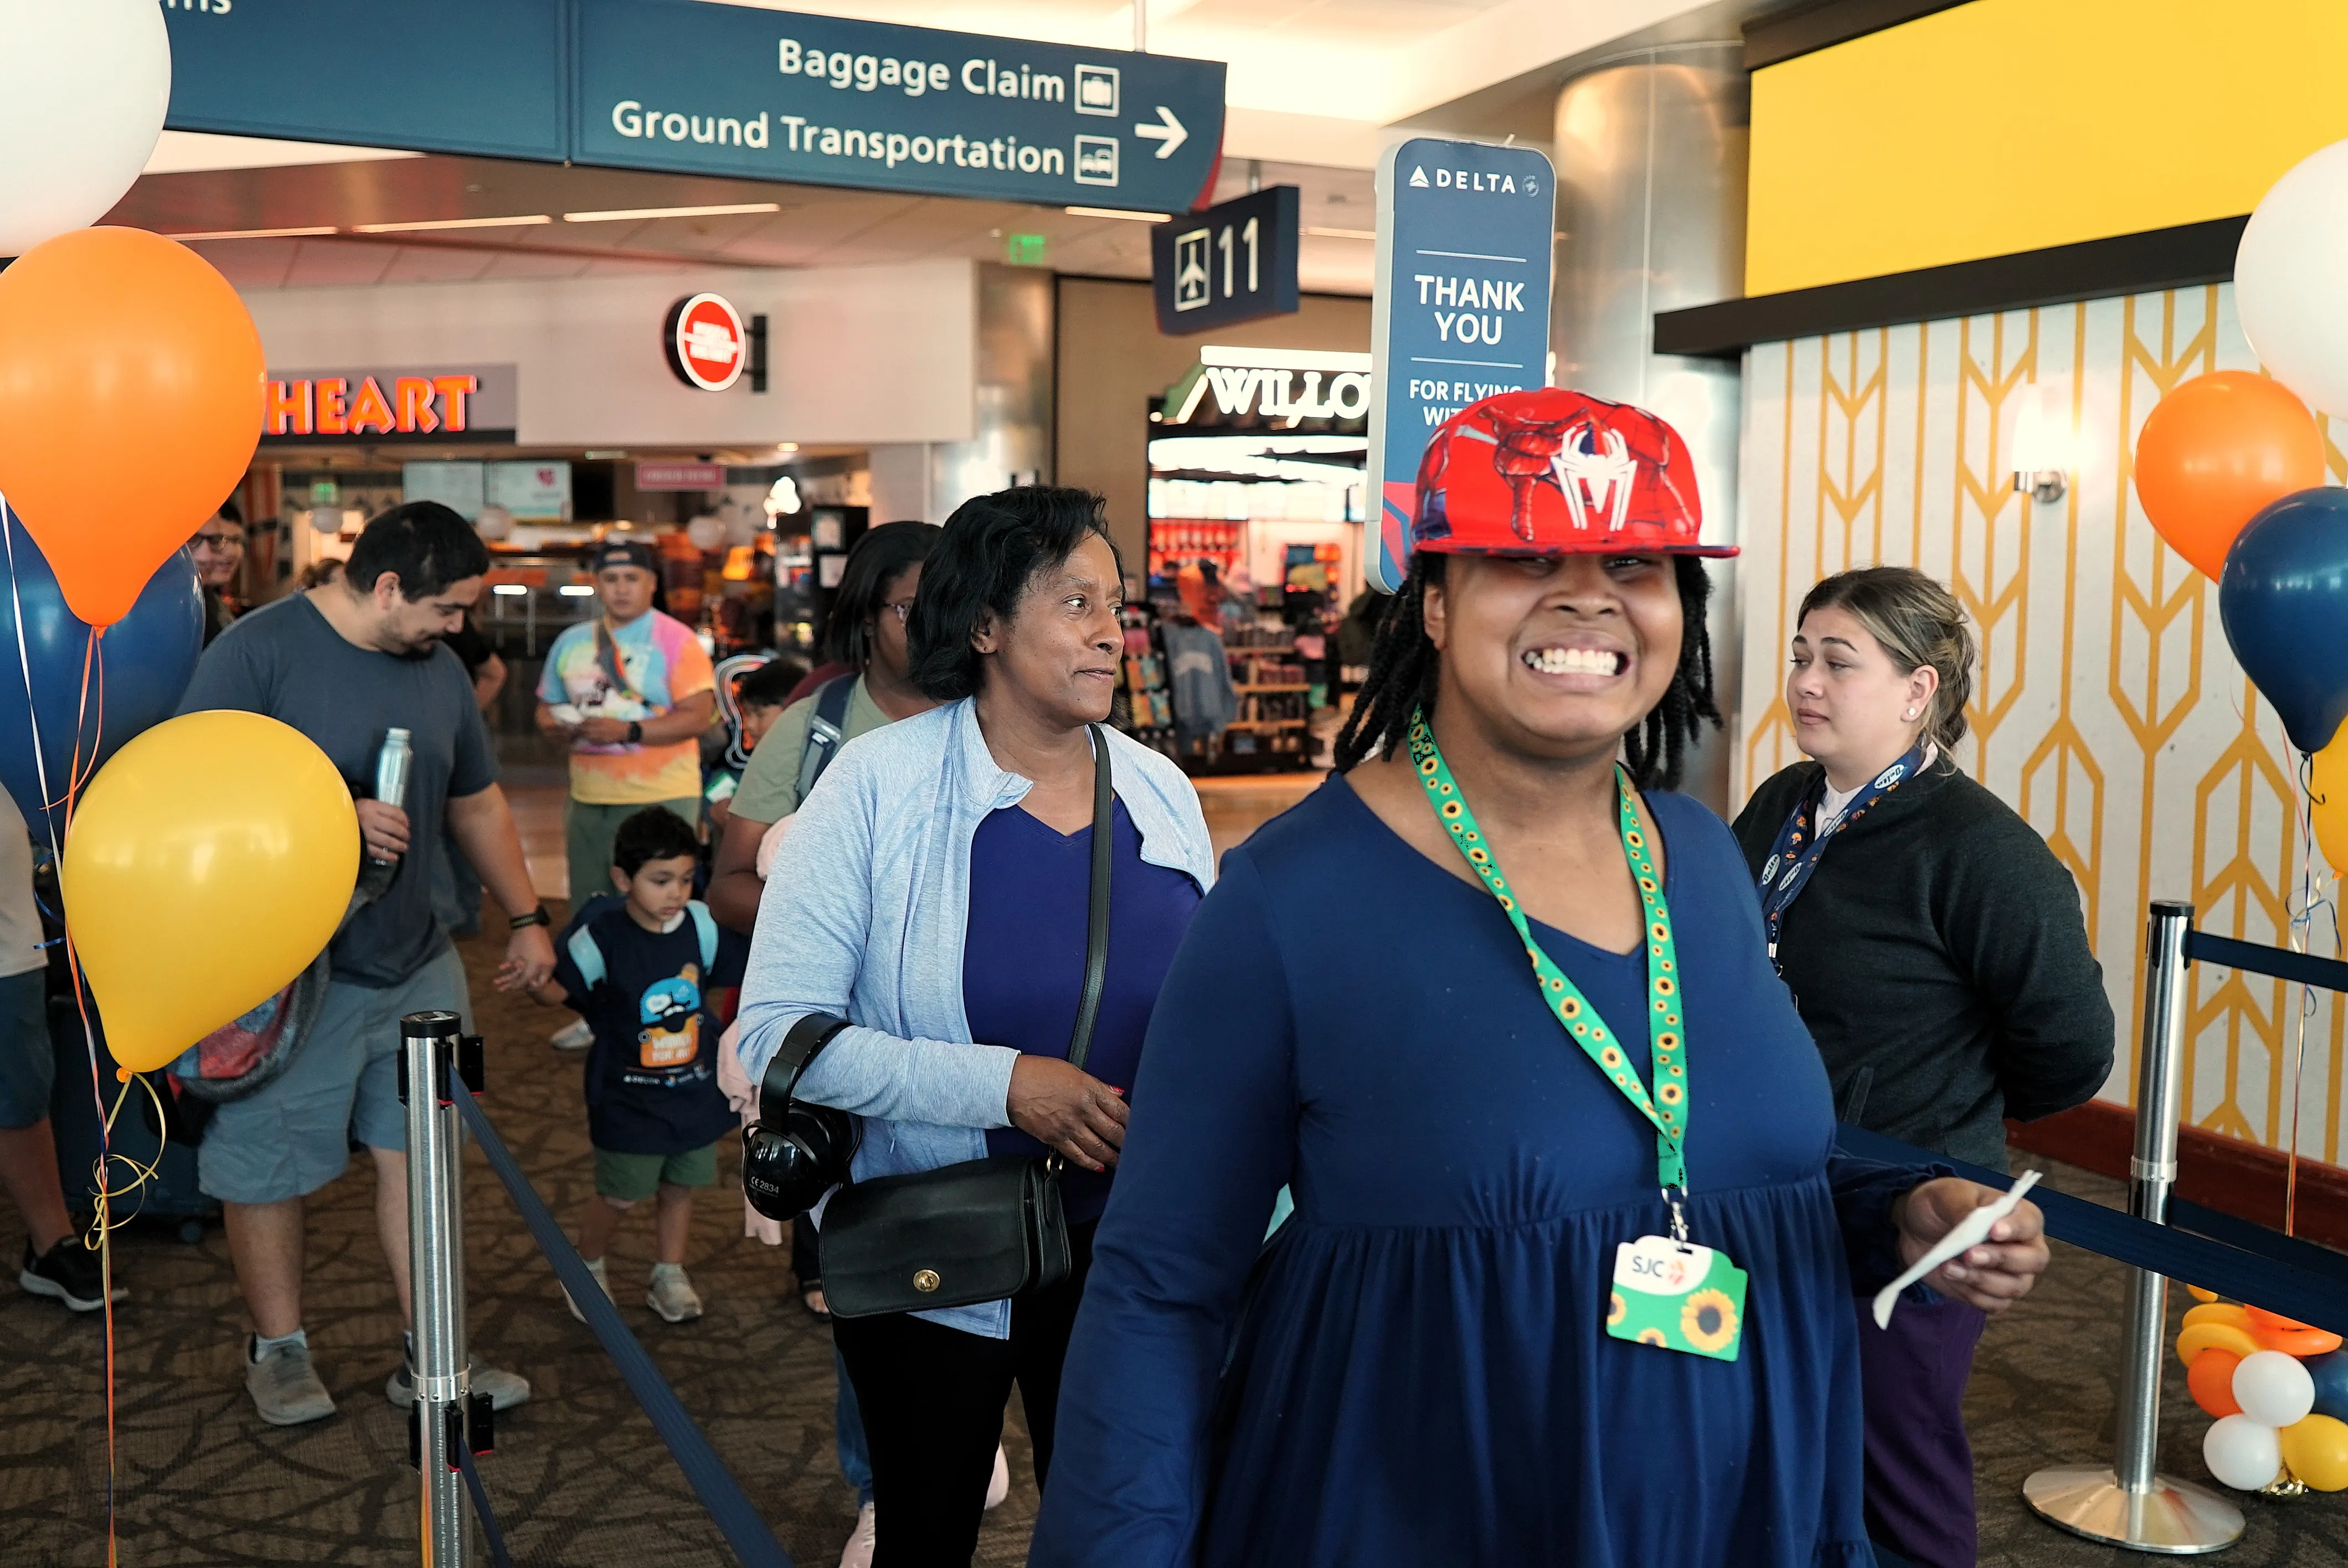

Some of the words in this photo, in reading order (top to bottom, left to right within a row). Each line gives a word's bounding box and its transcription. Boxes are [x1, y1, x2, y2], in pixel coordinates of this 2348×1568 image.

[778, 38, 950, 97] Baggage
[961, 58, 1065, 103] Claim
[611, 100, 769, 149] Ground
[779, 115, 1065, 176] Transportation
[1436, 168, 1516, 194] DELTA
[1218, 216, 1259, 298] 11
[1414, 274, 1525, 312] THANK
[1434, 311, 1502, 345] YOU
[267, 374, 478, 435] HEART
[1205, 367, 1373, 420] WILLO
[1409, 379, 1449, 401] FOR
[759, 1180, 779, 1194] 2834
[1632, 1255, 1664, 1277] SJC
